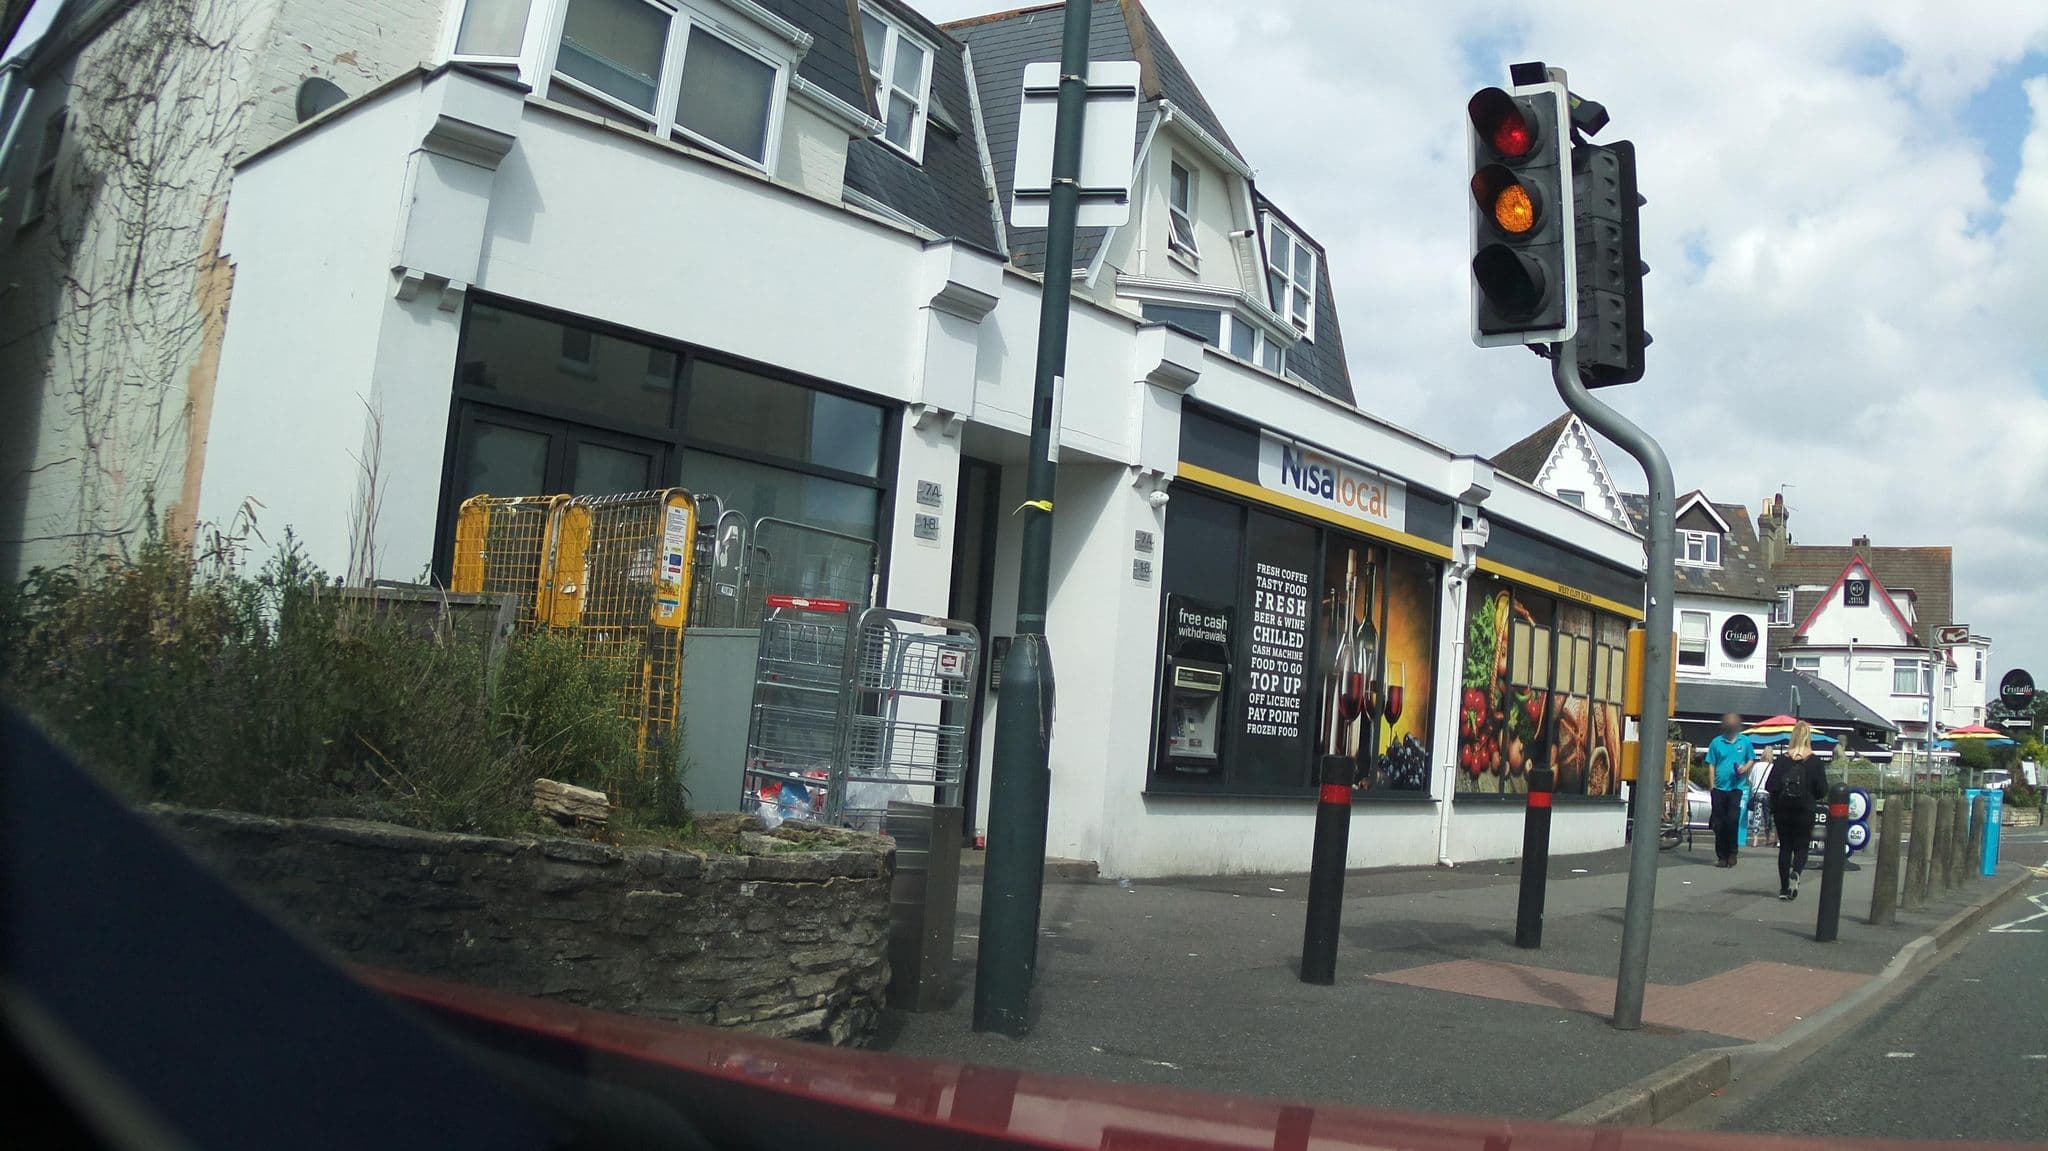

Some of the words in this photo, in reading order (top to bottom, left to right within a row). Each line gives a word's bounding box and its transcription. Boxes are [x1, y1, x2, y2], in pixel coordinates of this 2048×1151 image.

[1256, 562, 1280, 577] FRESH
[1281, 569, 1308, 583] COFFEE
[1256, 575, 1283, 592] TASTY
[1284, 582, 1307, 597] FOOD
[1255, 590, 1306, 617] FRESH
[1179, 607, 1201, 626] free
[1204, 615, 1228, 630] cash
[1254, 611, 1276, 625] BEER
[1277, 616, 1283, 627] &
[1284, 616, 1305, 631] WINE
[1178, 625, 1226, 643] withdrawals
[1253, 625, 1304, 648] CHILLED
[1725, 630, 1756, 641] Cristallo
[1252, 644, 1271, 656] CASH
[1272, 647, 1304, 661] MACHINE
[1251, 657, 1275, 671] FOOD
[1277, 661, 1289, 673] TO
[1290, 663, 1302, 675] GO
[1250, 671, 1280, 692] TOP
[1283, 676, 1301, 695] UP
[2002, 684, 2033, 695] Cristallo
[1249, 692, 1265, 705] OFF
[1266, 694, 1300, 709] LICENCE
[1248, 706, 1267, 721] PAY
[1268, 709, 1299, 724] POINT
[1246, 723, 1277, 736] FROZEN
[1277, 726, 1298, 737] FOOD
